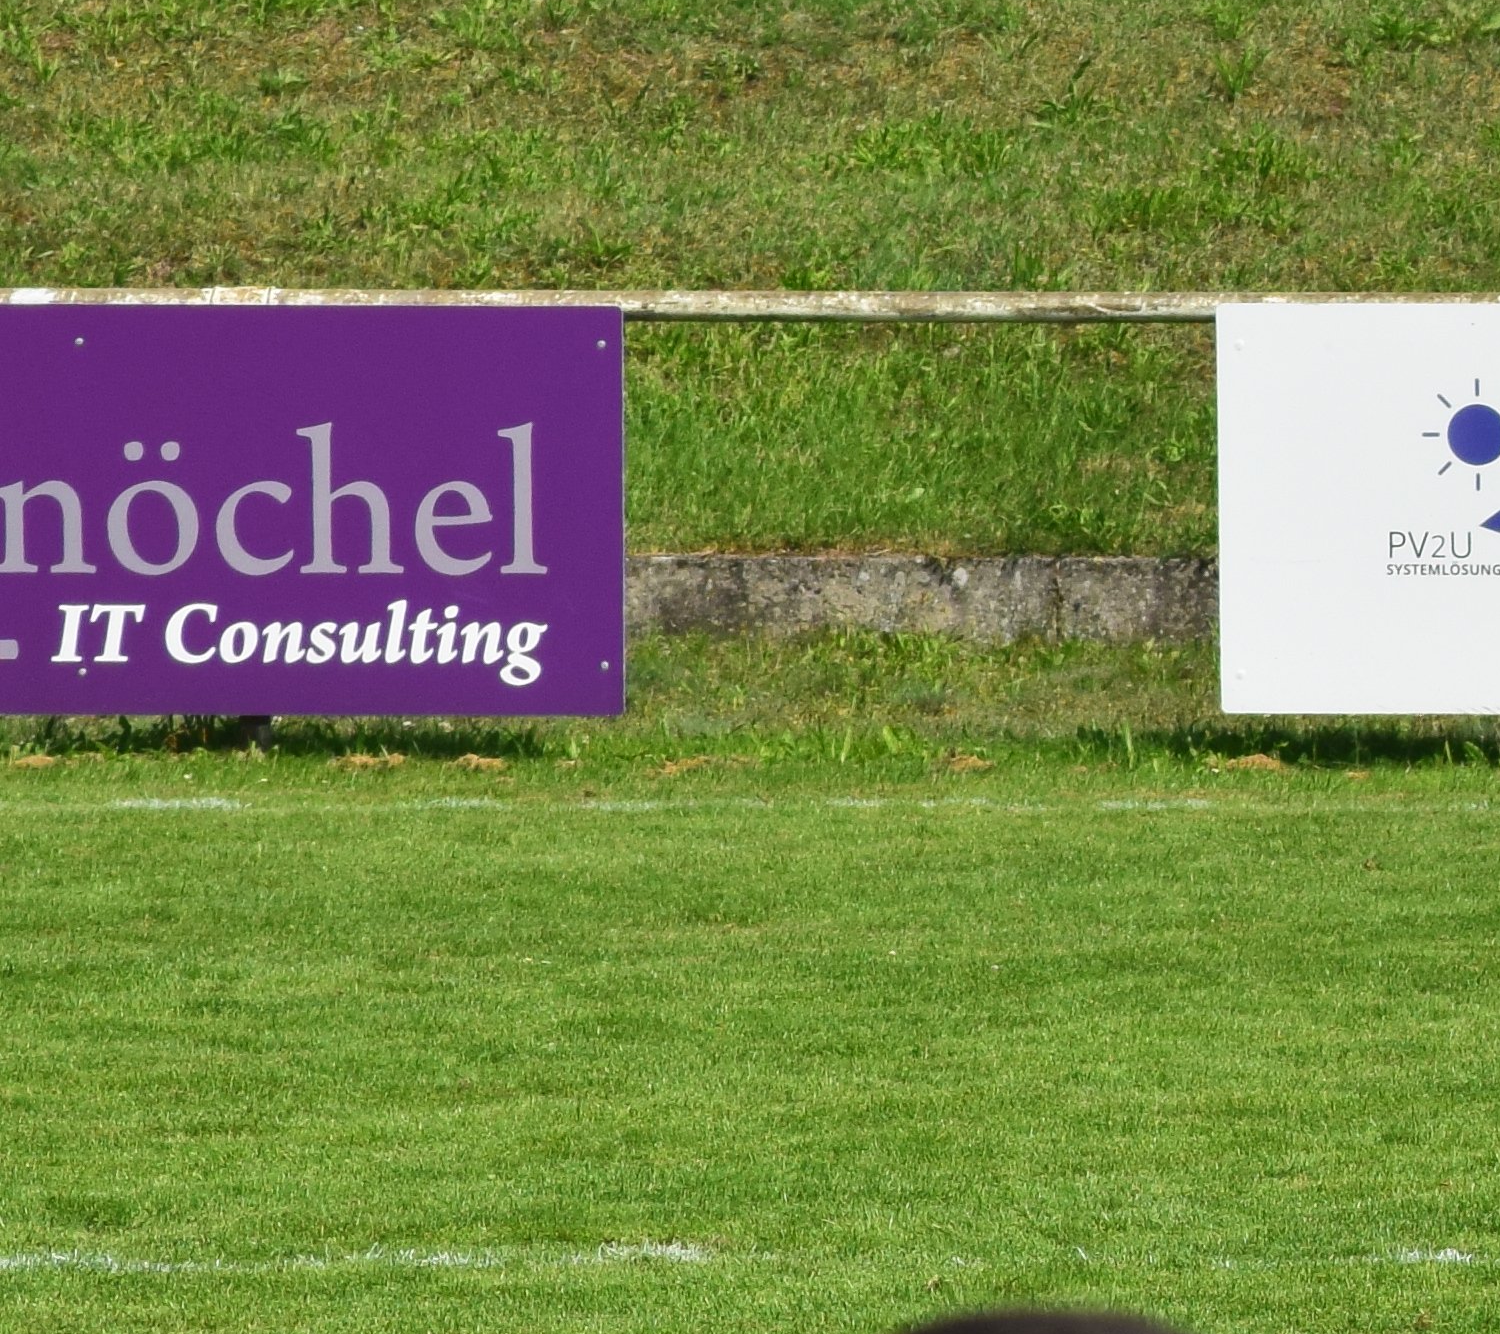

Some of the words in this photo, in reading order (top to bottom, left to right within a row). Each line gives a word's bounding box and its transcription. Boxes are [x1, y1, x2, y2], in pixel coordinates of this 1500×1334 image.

[1388, 531, 1474, 560] PV2U
[51, 603, 146, 663] IT
[164, 599, 549, 687] Consulting
